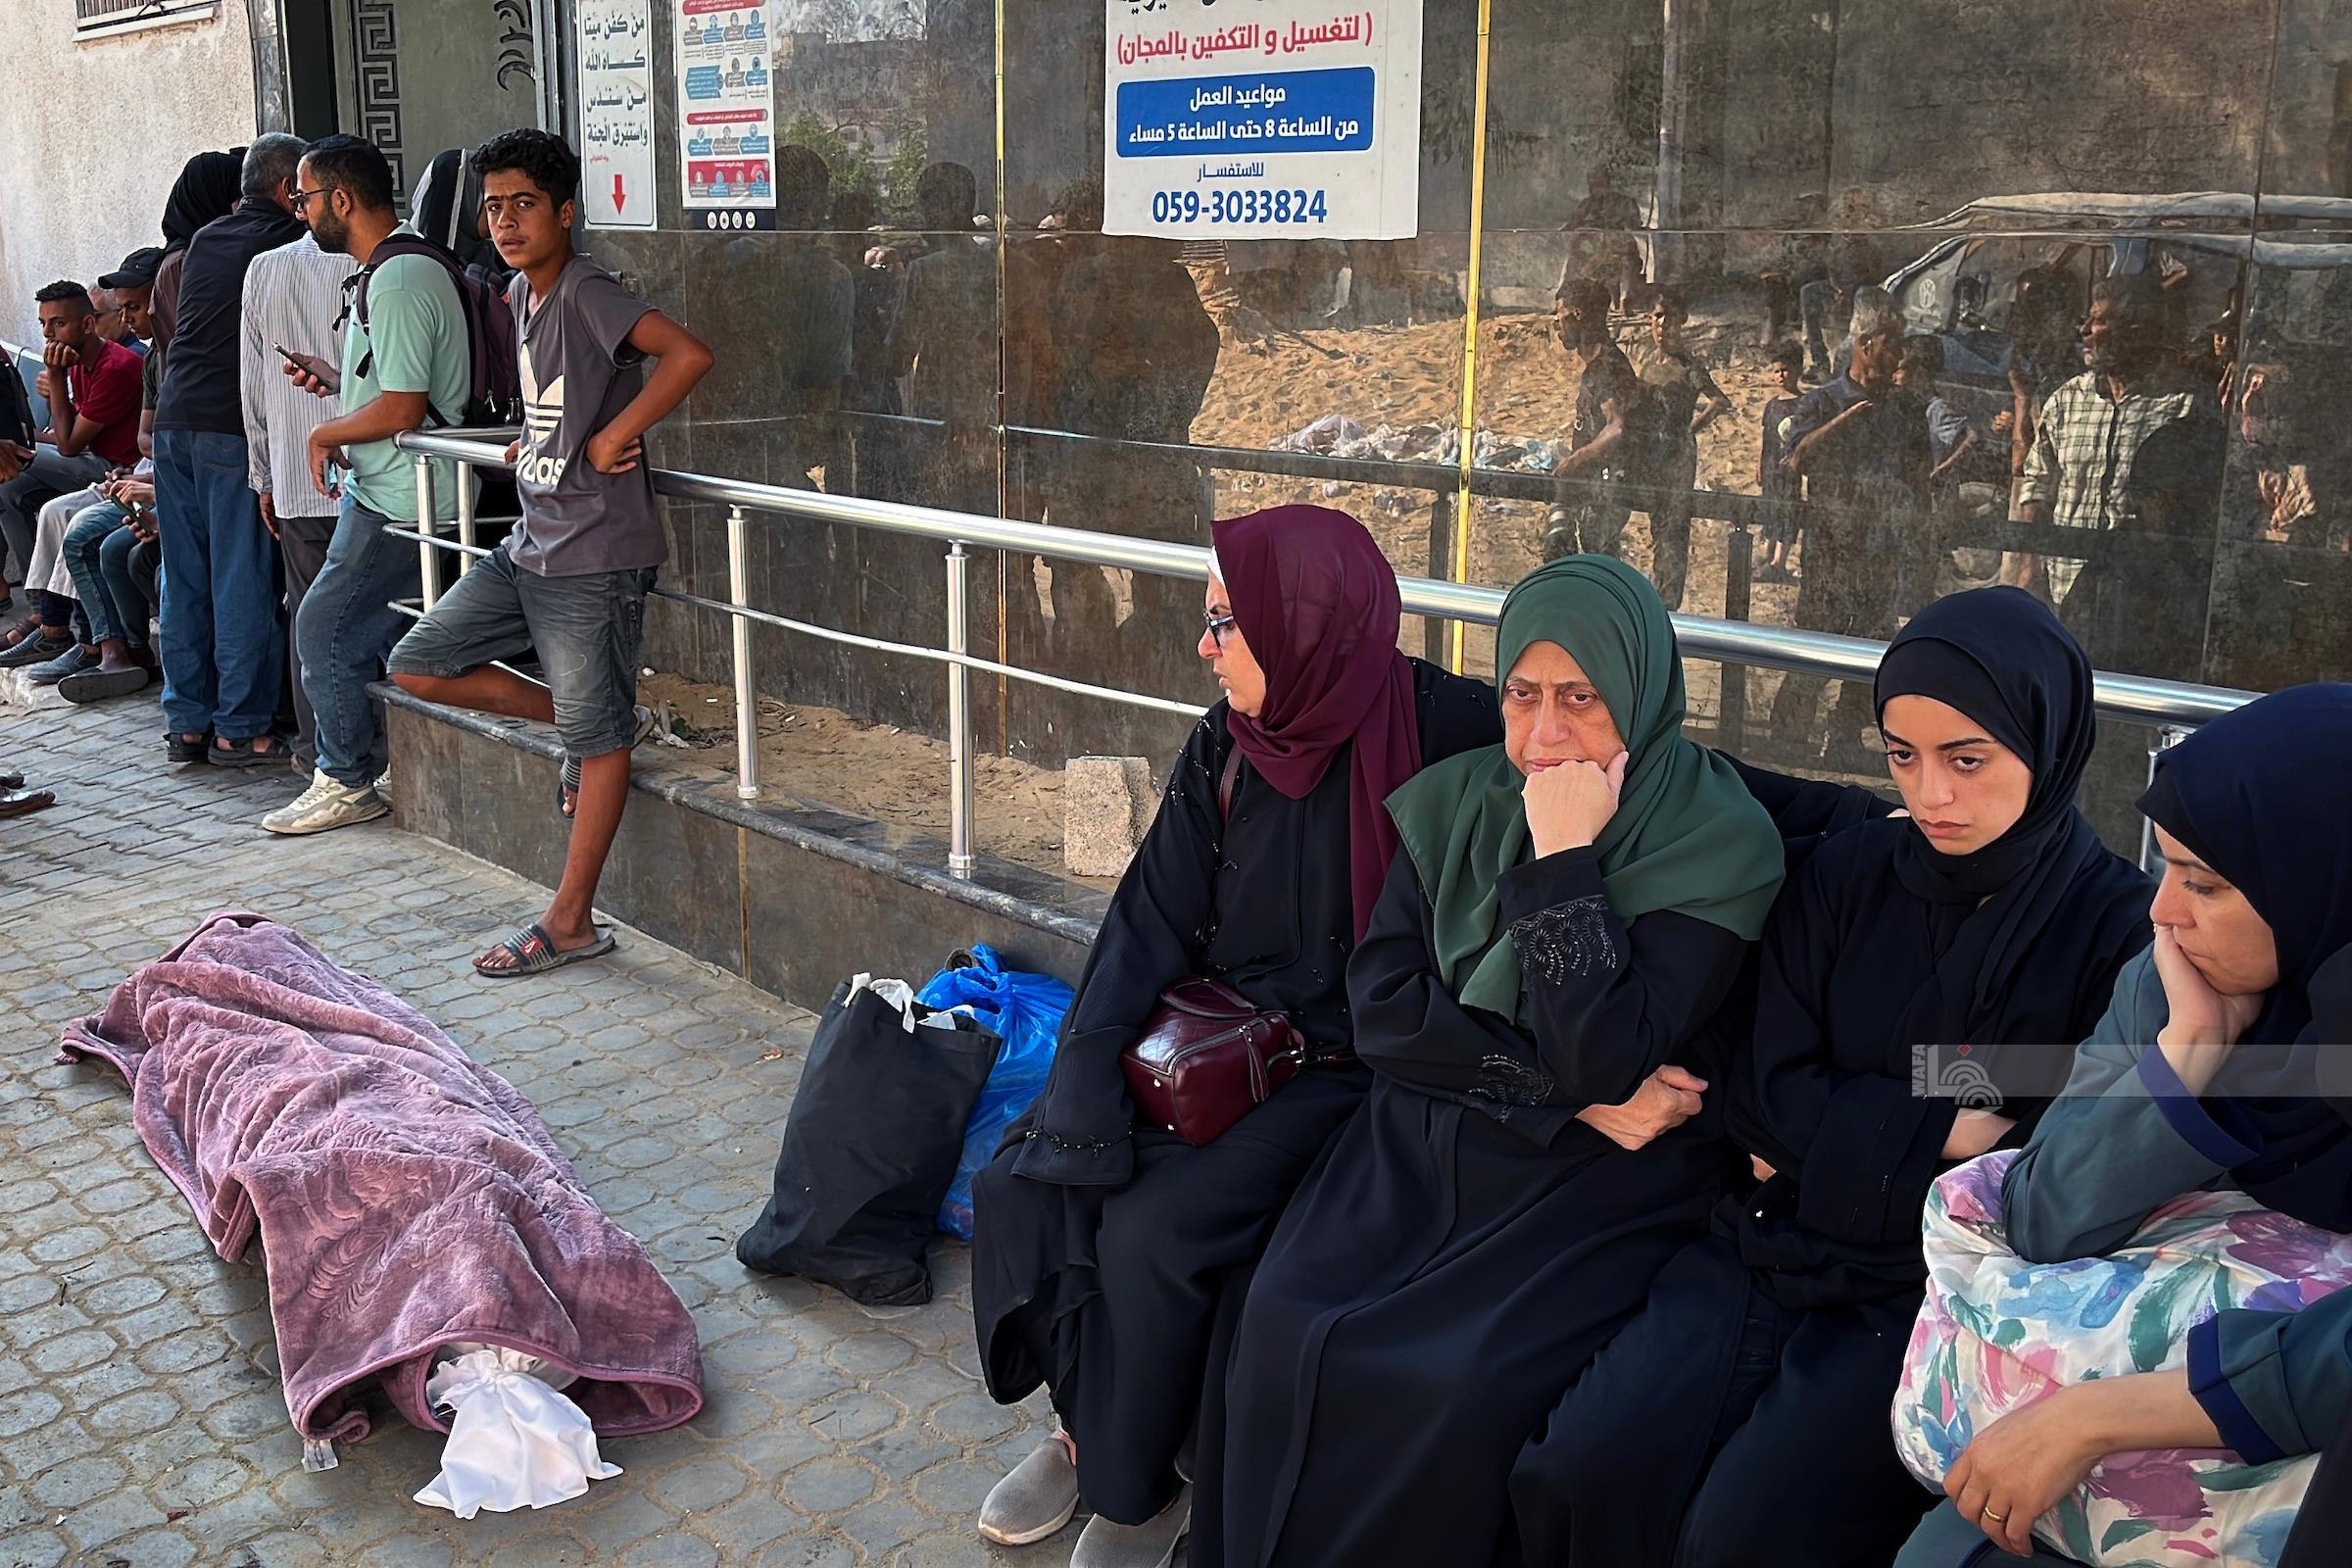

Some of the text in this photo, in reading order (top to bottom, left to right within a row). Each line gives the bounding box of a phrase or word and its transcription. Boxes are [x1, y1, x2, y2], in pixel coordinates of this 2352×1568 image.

[631, 13, 645, 38] من
[1117, 30, 1188, 66] بالمجان)
[1192, 24, 1260, 61] التكفين
[1264, 29, 1278, 56] و
[585, 49, 601, 72] الله
[627, 87, 647, 111] من
[1190, 83, 1287, 112] مواعيد العمل
[587, 121, 610, 147] الجنة
[1128, 116, 1359, 143] من الساعة 8 حتى الساعة 5 مساء
[1197, 162, 1264, 182] للاستفسار
[1152, 189, 1327, 223] 059-3033824
